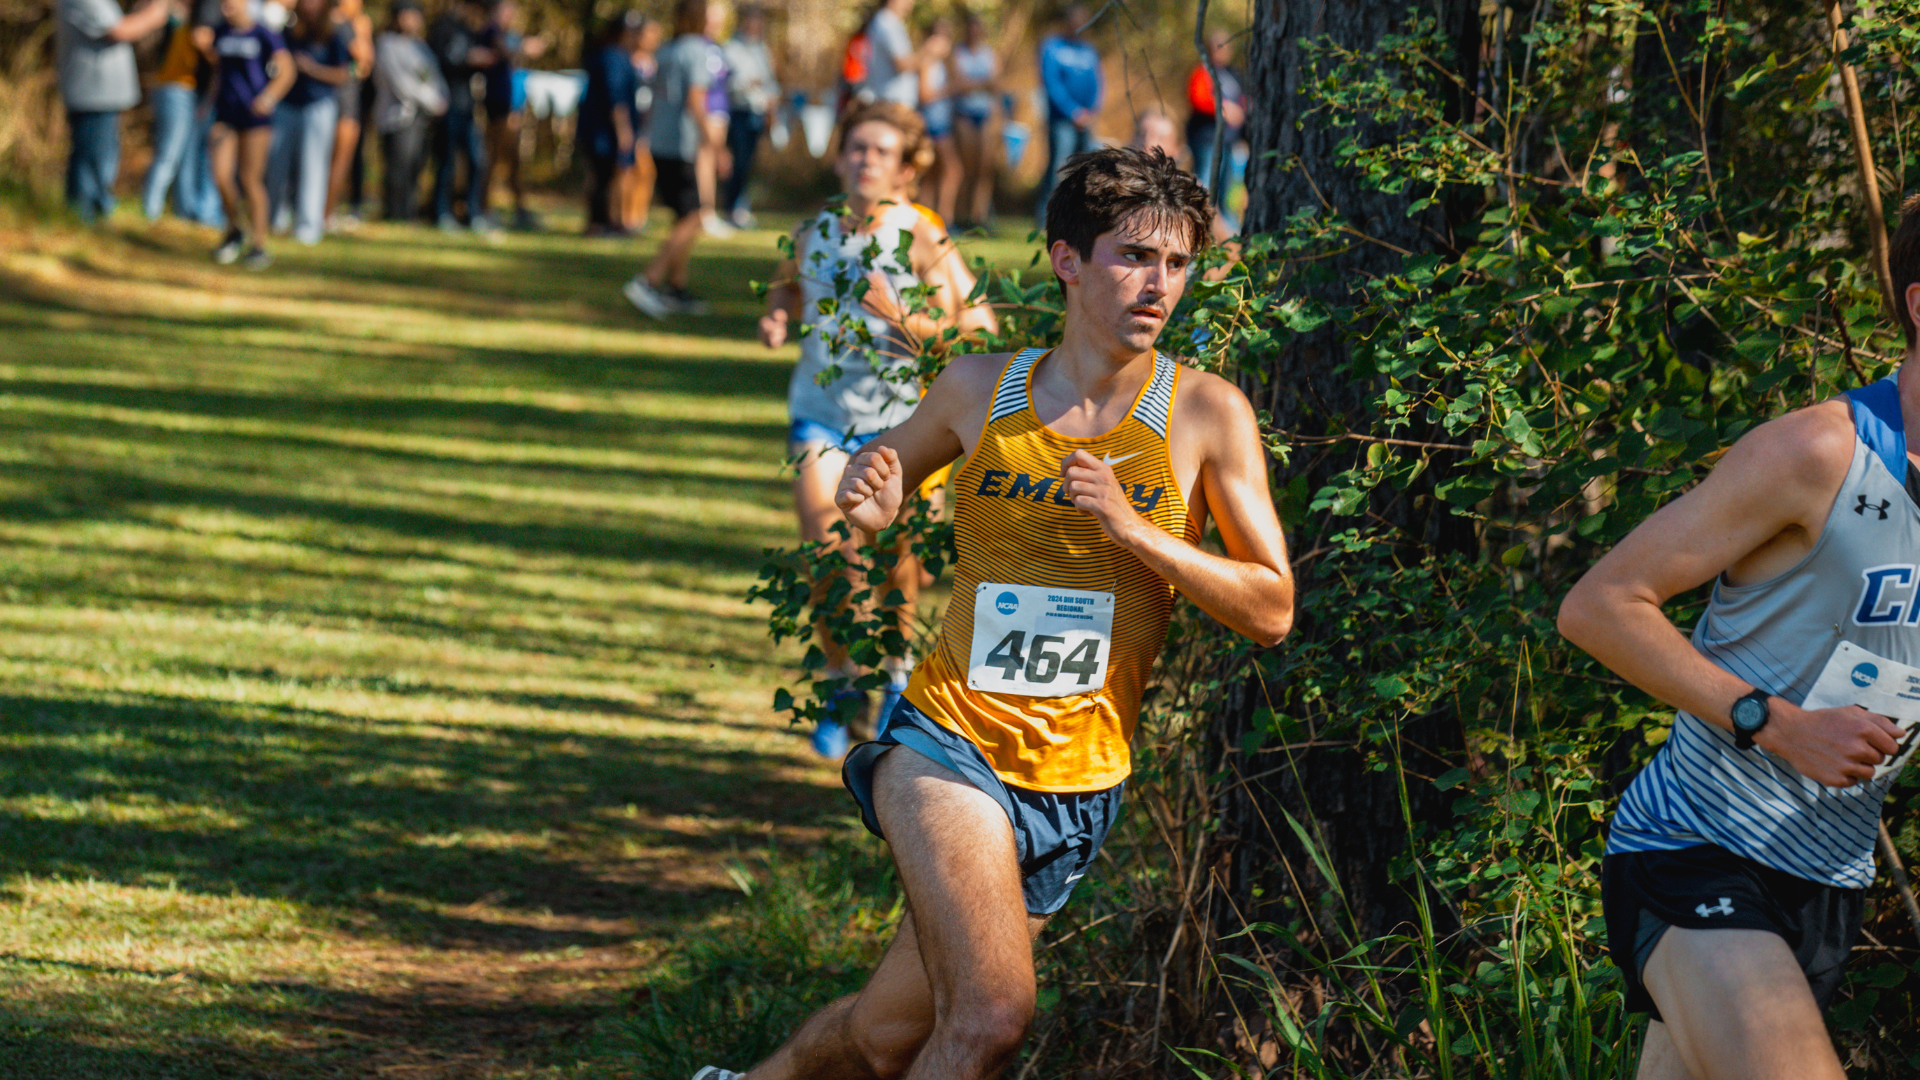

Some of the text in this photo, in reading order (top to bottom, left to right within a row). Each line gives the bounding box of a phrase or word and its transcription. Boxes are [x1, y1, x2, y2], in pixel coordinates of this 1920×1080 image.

[976, 469, 1165, 513] EMY
[997, 602, 1018, 610] NCAA
[1075, 597, 1095, 605] SOUTH
[1852, 563, 1920, 627] C
[1056, 604, 1084, 613] REGIONAL
[985, 630, 1100, 685] 464
